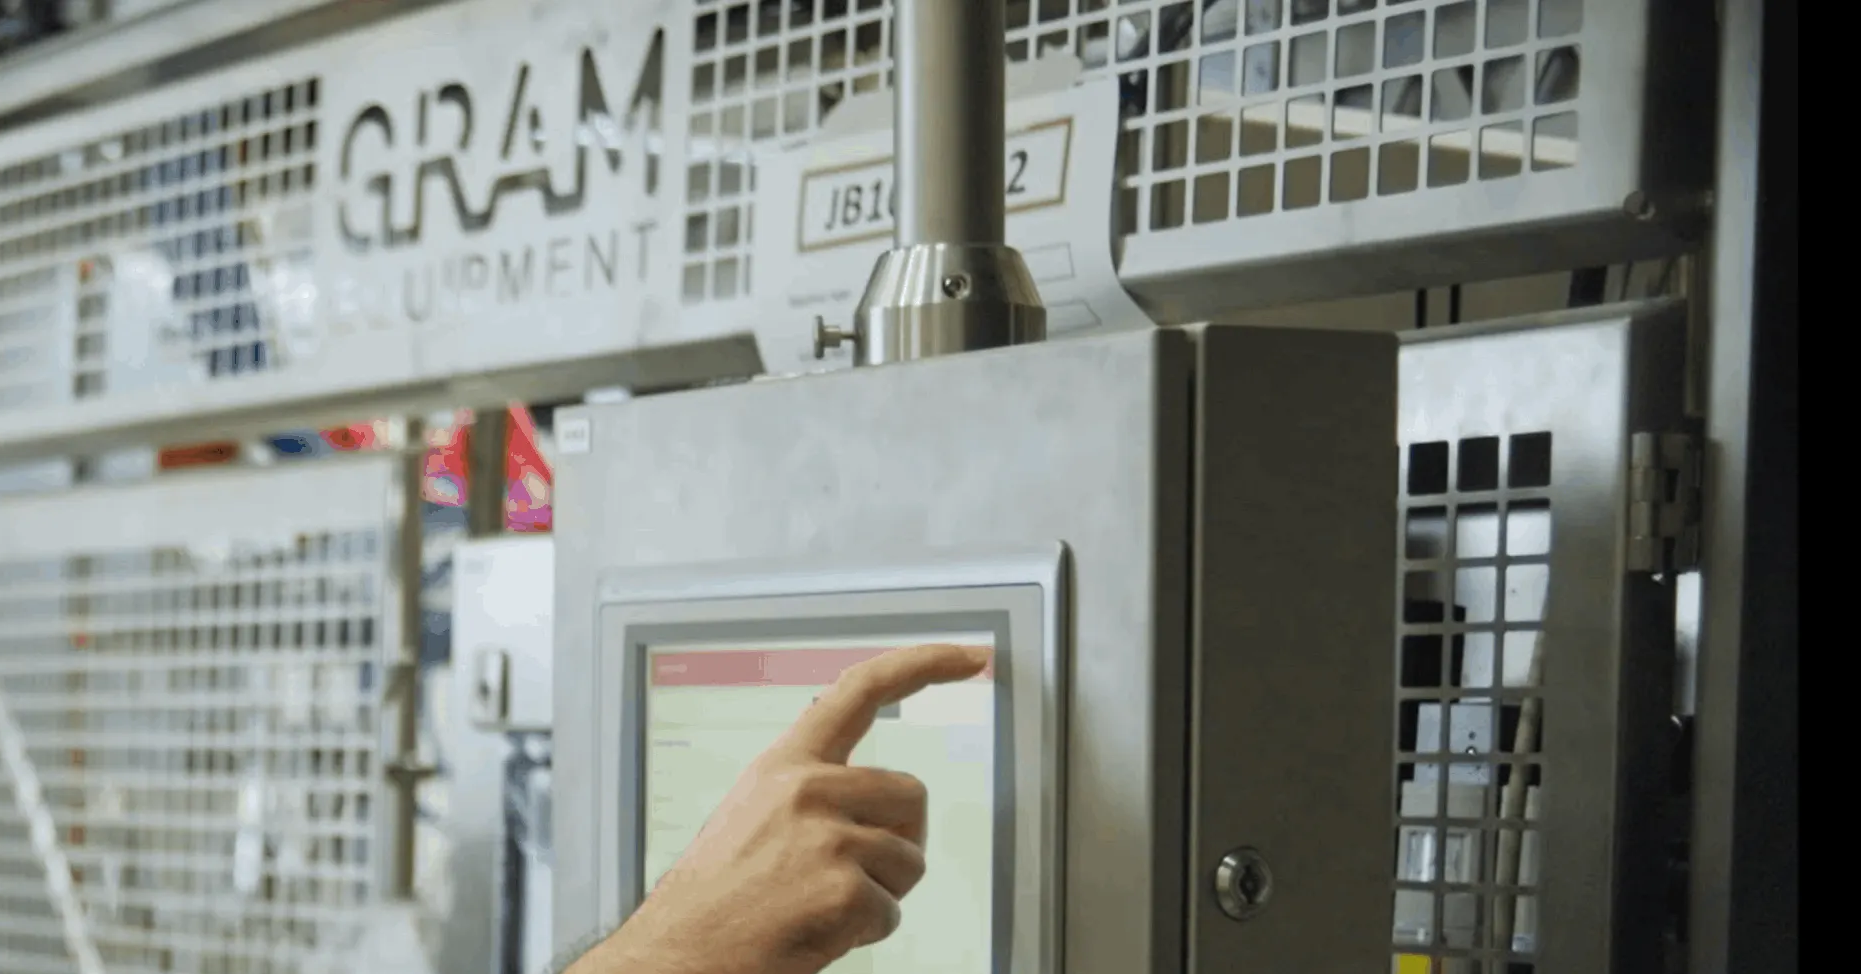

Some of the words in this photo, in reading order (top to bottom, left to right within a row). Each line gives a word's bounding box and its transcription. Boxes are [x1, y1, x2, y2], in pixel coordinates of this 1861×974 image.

[340, 27, 665, 253] GRAM
[823, 178, 895, 231] JB1
[328, 217, 658, 336] UIPMENT
